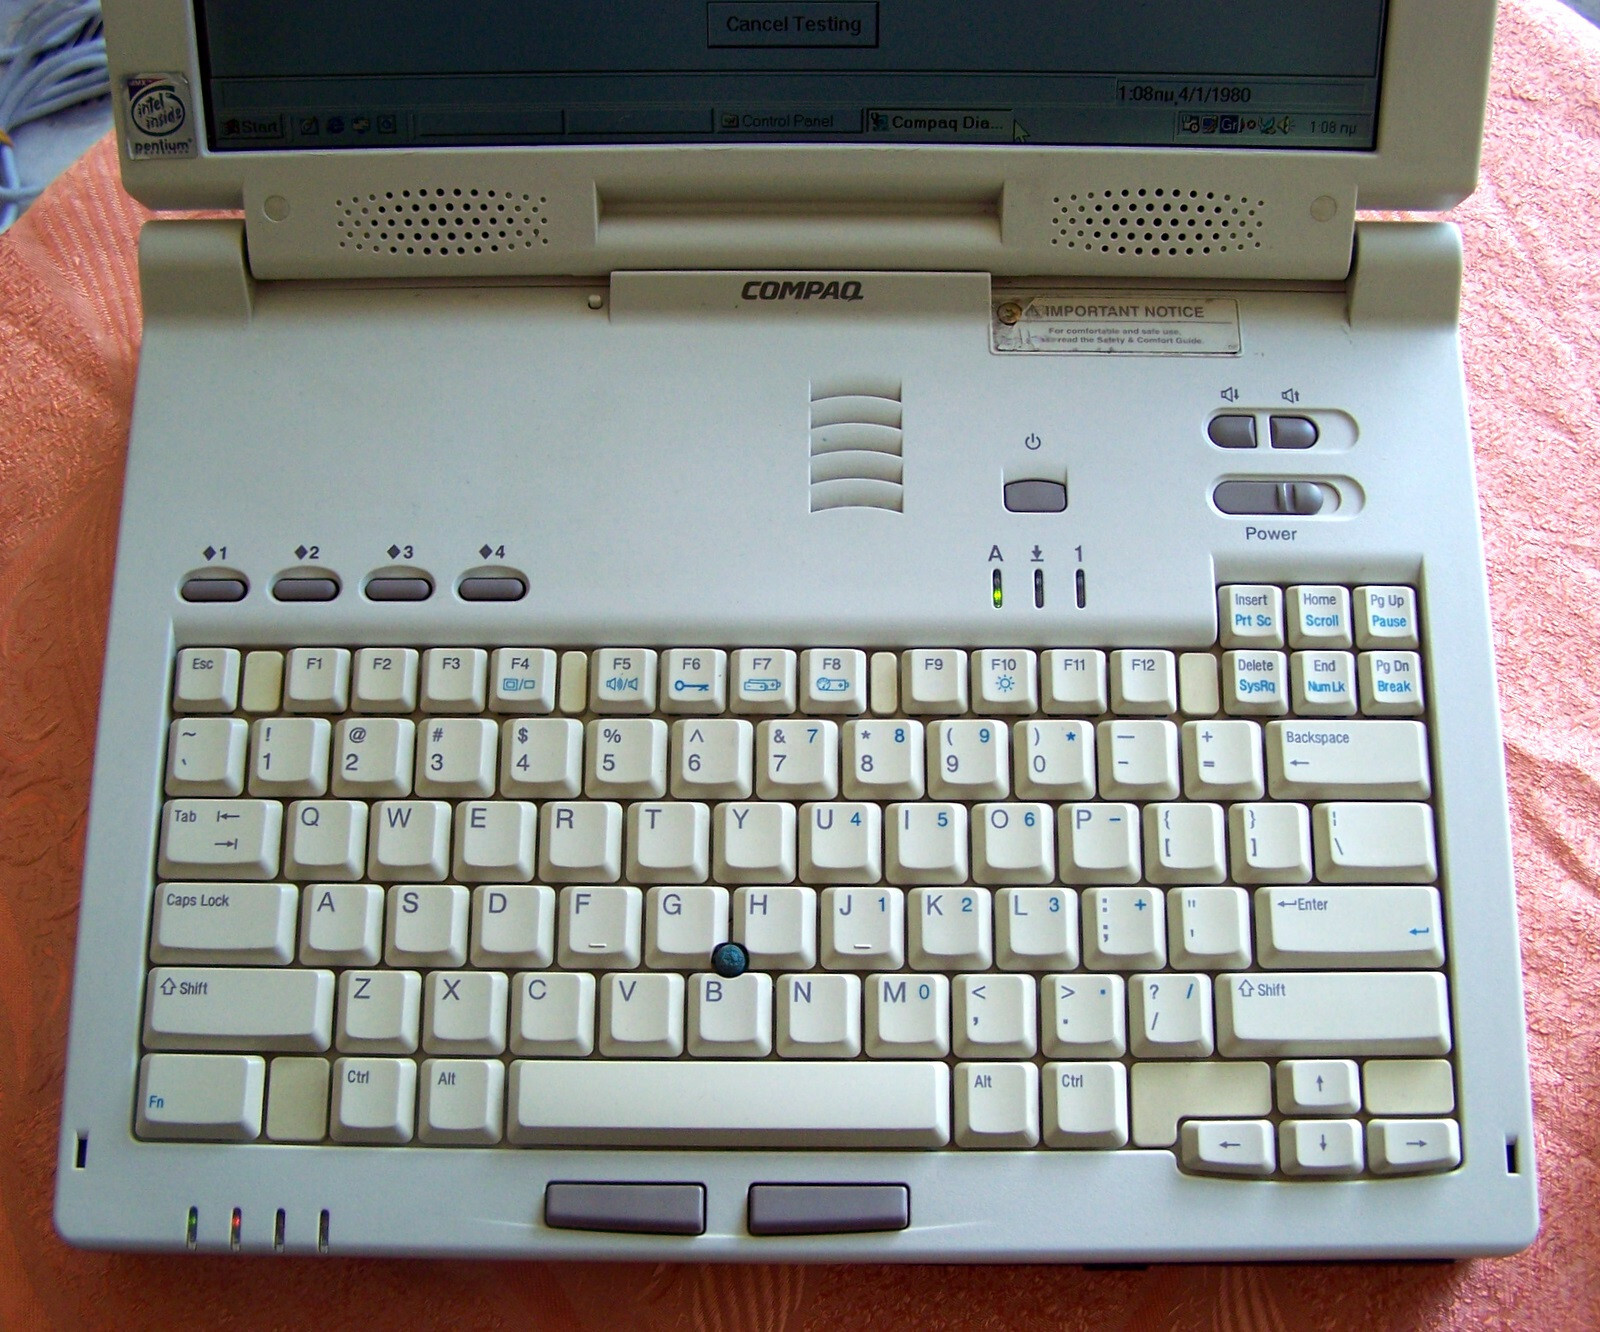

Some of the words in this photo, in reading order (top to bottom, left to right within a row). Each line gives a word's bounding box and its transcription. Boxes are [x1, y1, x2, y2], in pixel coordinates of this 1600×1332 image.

[726, 15, 789, 32] Cancel
[793, 15, 862, 35] Testing
[137, 93, 164, 118] intel
[145, 106, 182, 130] inside
[742, 114, 790, 128] Control
[793, 114, 834, 128] Panel
[892, 115, 958, 131] Compaq
[241, 120, 278, 134] Start
[135, 138, 189, 154] pentium
[741, 280, 864, 302] COMPAQ
[1045, 305, 1139, 317] IMPORTANT
[1145, 306, 1205, 318] NOTICE
[1048, 327, 1064, 335] For
[1066, 327, 1120, 336] comfortable
[1122, 327, 1140, 336] and
[1141, 328, 1160, 336] safe
[1057, 337, 1078, 345] read
[1080, 336, 1095, 344] the
[1097, 336, 1125, 346] Safety
[1128, 336, 1134, 344] &
[1137, 337, 1173, 345] Comfort
[1246, 527, 1297, 540] Power
[309, 546, 319, 559] 2
[404, 546, 413, 559] 3
[495, 545, 505, 558] 4
[988, 545, 1003, 561] A
[1236, 594, 1268, 605] Insert
[1304, 594, 1336, 605] Home
[1371, 594, 1385, 608] Pg
[1389, 595, 1404, 608] Up
[1236, 614, 1252, 626] Prt
[1257, 615, 1271, 626] Sc
[1306, 615, 1339, 626] Scroll
[1373, 615, 1406, 627] Pause
[193, 658, 213, 669] Esc
[307, 658, 322, 669] F1
[373, 658, 391, 670] F2
[443, 658, 460, 669] F3
[512, 658, 529, 669] F4
[614, 658, 631, 670] F5
[683, 658, 700, 670] F6
[753, 658, 772, 670] F7
[823, 658, 841, 670] F8
[926, 659, 943, 670] F9
[992, 659, 1016, 670] F10
[1065, 659, 1084, 670] F11
[1132, 659, 1155, 671] F12
[1239, 659, 1273, 671] Delete
[1314, 660, 1336, 671] End
[1376, 660, 1390, 674] Pg
[1394, 660, 1409, 671] Dn
[1240, 679, 1275, 693] SysRq
[1378, 681, 1411, 692] Break
[349, 727, 366, 743] @
[433, 728, 443, 742] #
[518, 727, 528, 744] $
[604, 729, 621, 743] %
[774, 729, 785, 743] &
[807, 729, 818, 743] 7
[895, 729, 905, 742] 8
[980, 729, 990, 743] 9
[1287, 731, 1349, 745] Backspace
[263, 753, 270, 769] 1
[346, 754, 358, 770] 2
[431, 754, 443, 770] 3
[517, 754, 529, 771] 4
[603, 754, 615, 771] 5
[689, 754, 700, 771] 6
[774, 755, 786, 771] 7
[861, 755, 873, 772] 8
[947, 755, 958, 772] 9
[1034, 755, 1045, 772] 0
[175, 810, 196, 822] Tab
[302, 807, 319, 826] Q
[388, 808, 411, 827] W
[471, 808, 486, 828] E
[557, 809, 573, 828] R
[645, 809, 662, 829] T
[733, 809, 749, 829] Y
[817, 809, 833, 829] U
[851, 812, 861, 826] 4
[938, 812, 948, 827] 5
[1025, 812, 1035, 827] 6
[1077, 810, 1092, 829] P
[167, 893, 196, 908] Caps
[201, 895, 229, 906] Lock
[317, 892, 334, 912] A
[403, 893, 418, 913] S
[489, 893, 506, 913] D
[576, 894, 591, 914] F
[663, 894, 681, 915] G
[750, 894, 767, 915] H
[840, 895, 851, 915] J
[879, 897, 884, 911] 1
[928, 895, 943, 915] K
[962, 897, 972, 912] 2
[1015, 895, 1027, 915] L
[1050, 897, 1059, 912] 3
[1298, 898, 1328, 910] Enter
[180, 982, 207, 994] Shift
[354, 978, 371, 999] Z
[443, 979, 460, 1000] X
[529, 980, 546, 1000] C
[619, 981, 636, 1001] V
[706, 981, 722, 1001] B
[795, 982, 811, 1003] N
[884, 982, 905, 1002] M
[1150, 985, 1159, 999] ?
[1258, 983, 1285, 996] Shift
[348, 1070, 369, 1083] Ctrl
[438, 1072, 455, 1085] Alt
[975, 1075, 992, 1088] Alt
[1062, 1074, 1083, 1087] Ctrl
[149, 1095, 164, 1108] Fn
